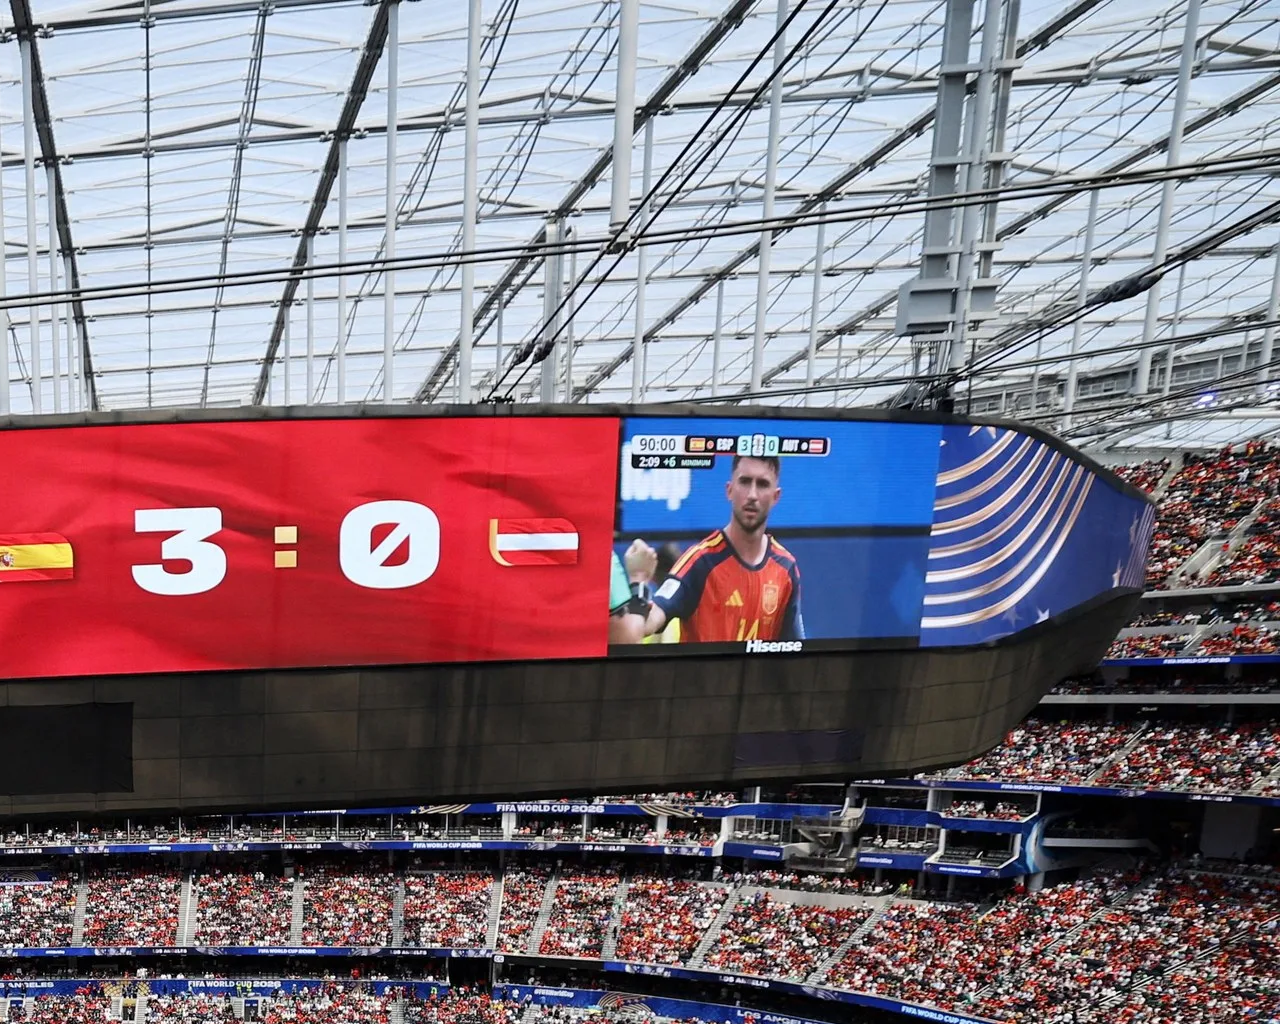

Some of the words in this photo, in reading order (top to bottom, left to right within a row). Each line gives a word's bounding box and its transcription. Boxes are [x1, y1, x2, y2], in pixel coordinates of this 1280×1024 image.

[640, 437, 676, 451] 90:00
[716, 438, 734, 450] ESP
[741, 439, 748, 451] 3
[768, 439, 775, 451] 0
[639, 456, 660, 467] 2:09
[663, 456, 675, 467] +6
[130, 506, 228, 596] 3
[339, 499, 441, 590] 0
[746, 640, 803, 653] Hisense
[496, 804, 515, 812] FIFA
[517, 804, 550, 812] WORLD
[551, 804, 570, 812] CUP
[737, 1009, 762, 1019] LOS
[901, 1005, 917, 1015] FIFA
[917, 1008, 943, 1021] WORLD
[944, 1014, 959, 1024] CUP
